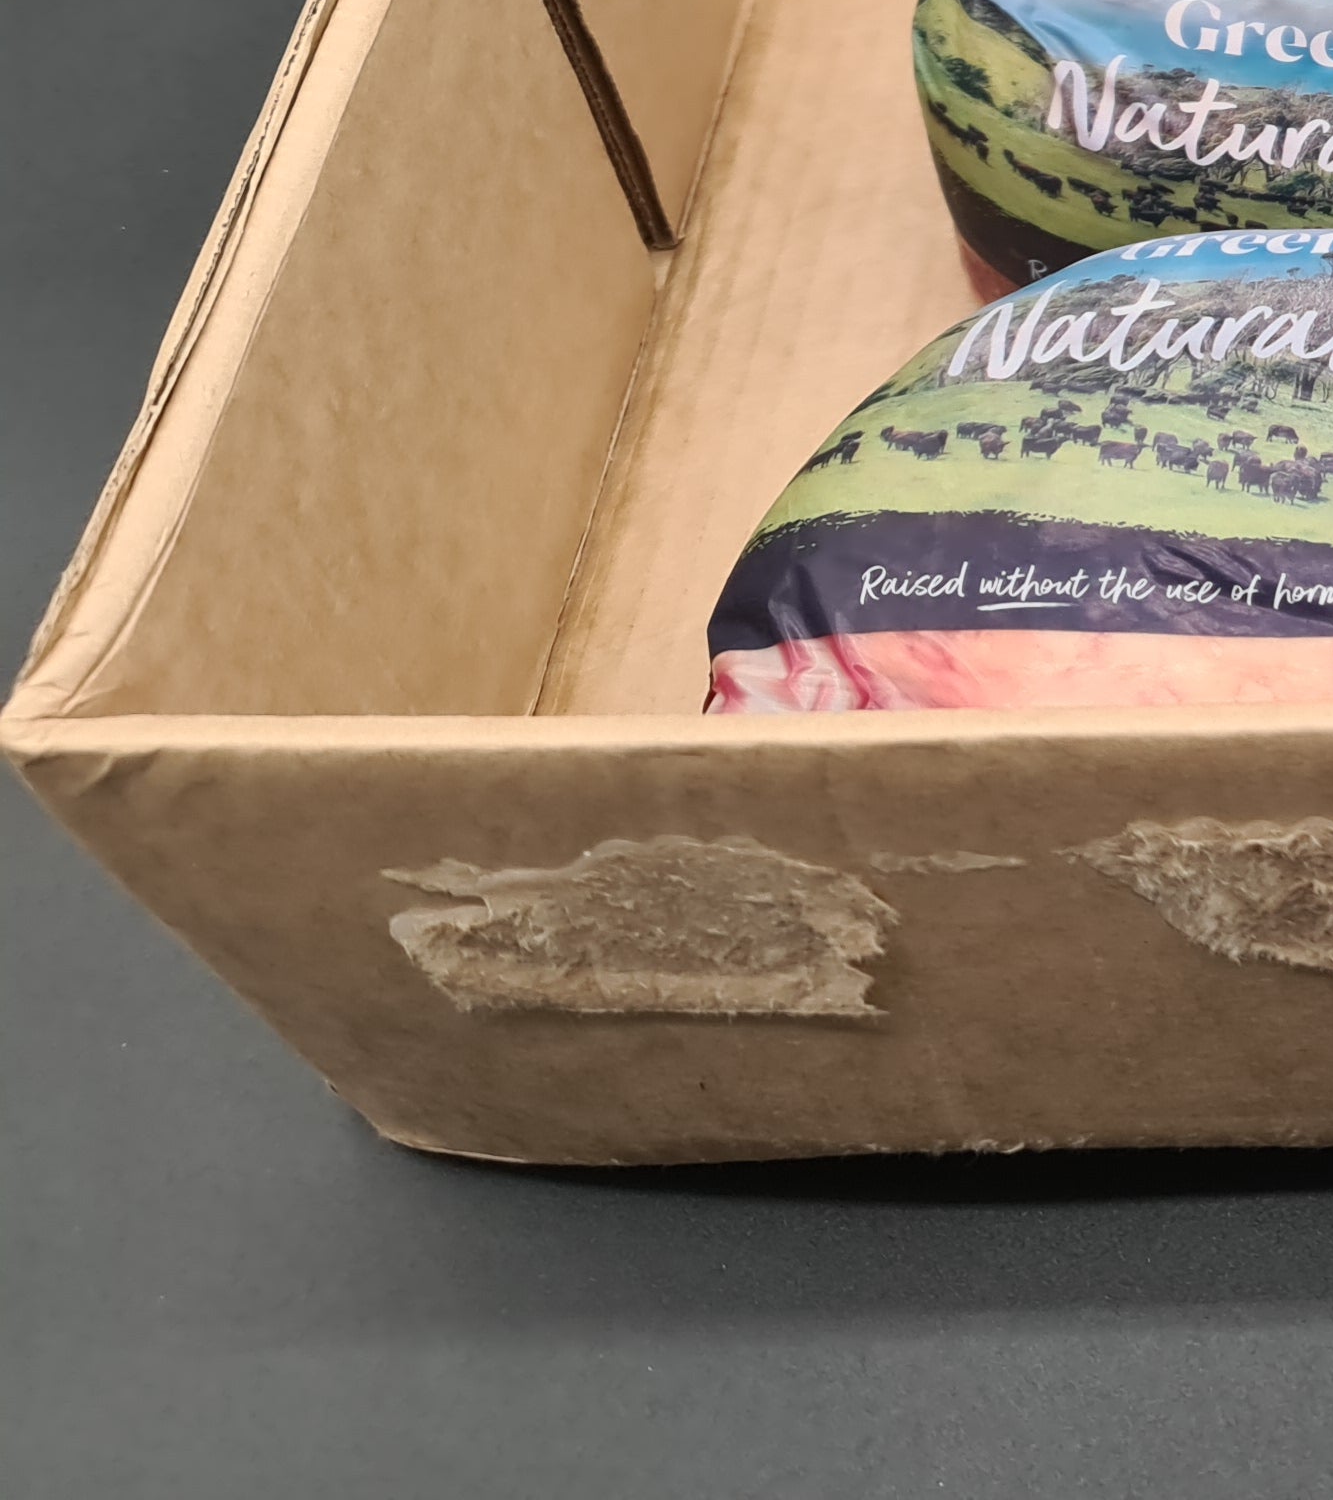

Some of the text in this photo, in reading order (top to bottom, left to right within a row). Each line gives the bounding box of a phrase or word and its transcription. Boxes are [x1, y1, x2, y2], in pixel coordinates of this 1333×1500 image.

[860, 561, 968, 605] Raised
[979, 564, 1090, 602] without
[1098, 567, 1156, 604] the
[1166, 580, 1221, 604] use
[1231, 574, 1260, 606] of
